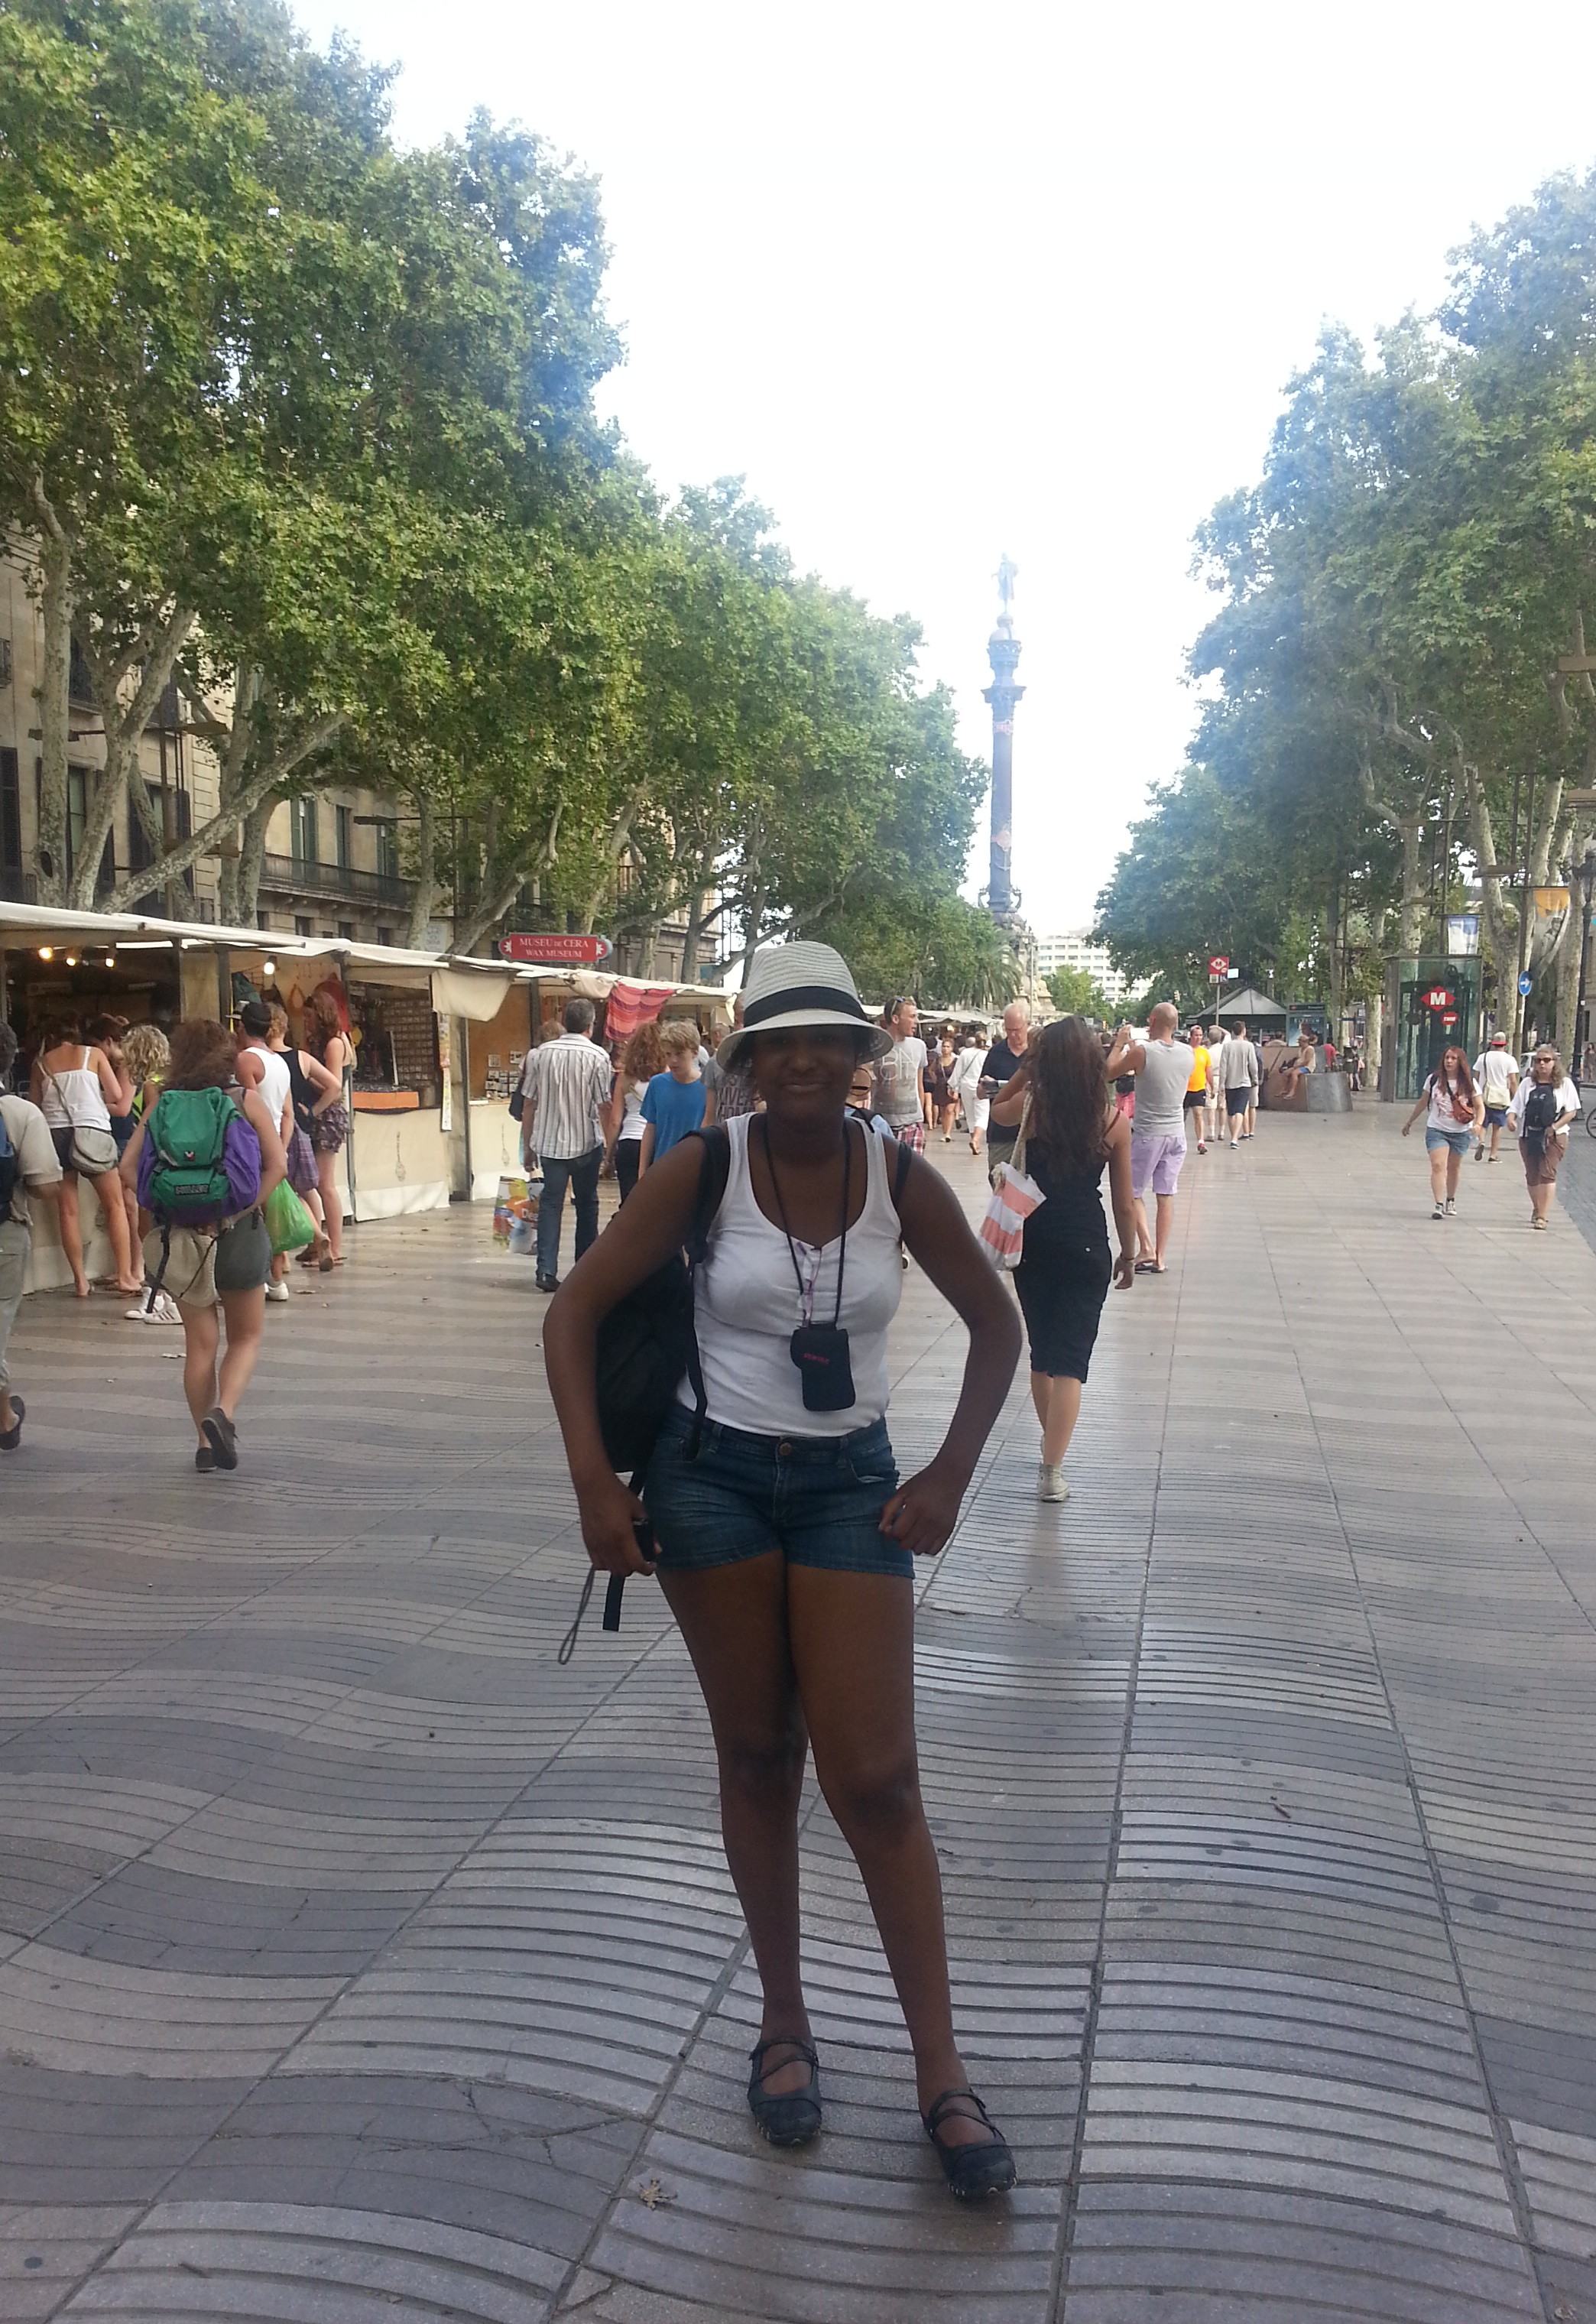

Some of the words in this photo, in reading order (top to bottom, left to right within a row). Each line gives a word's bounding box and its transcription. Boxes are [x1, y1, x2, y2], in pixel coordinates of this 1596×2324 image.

[519, 937, 553, 947] MUSEU
[563, 939, 589, 948] CERA
[525, 949, 544, 957] WAX
[546, 949, 582, 958] MUSEUM
[1430, 992, 1446, 1005] M
